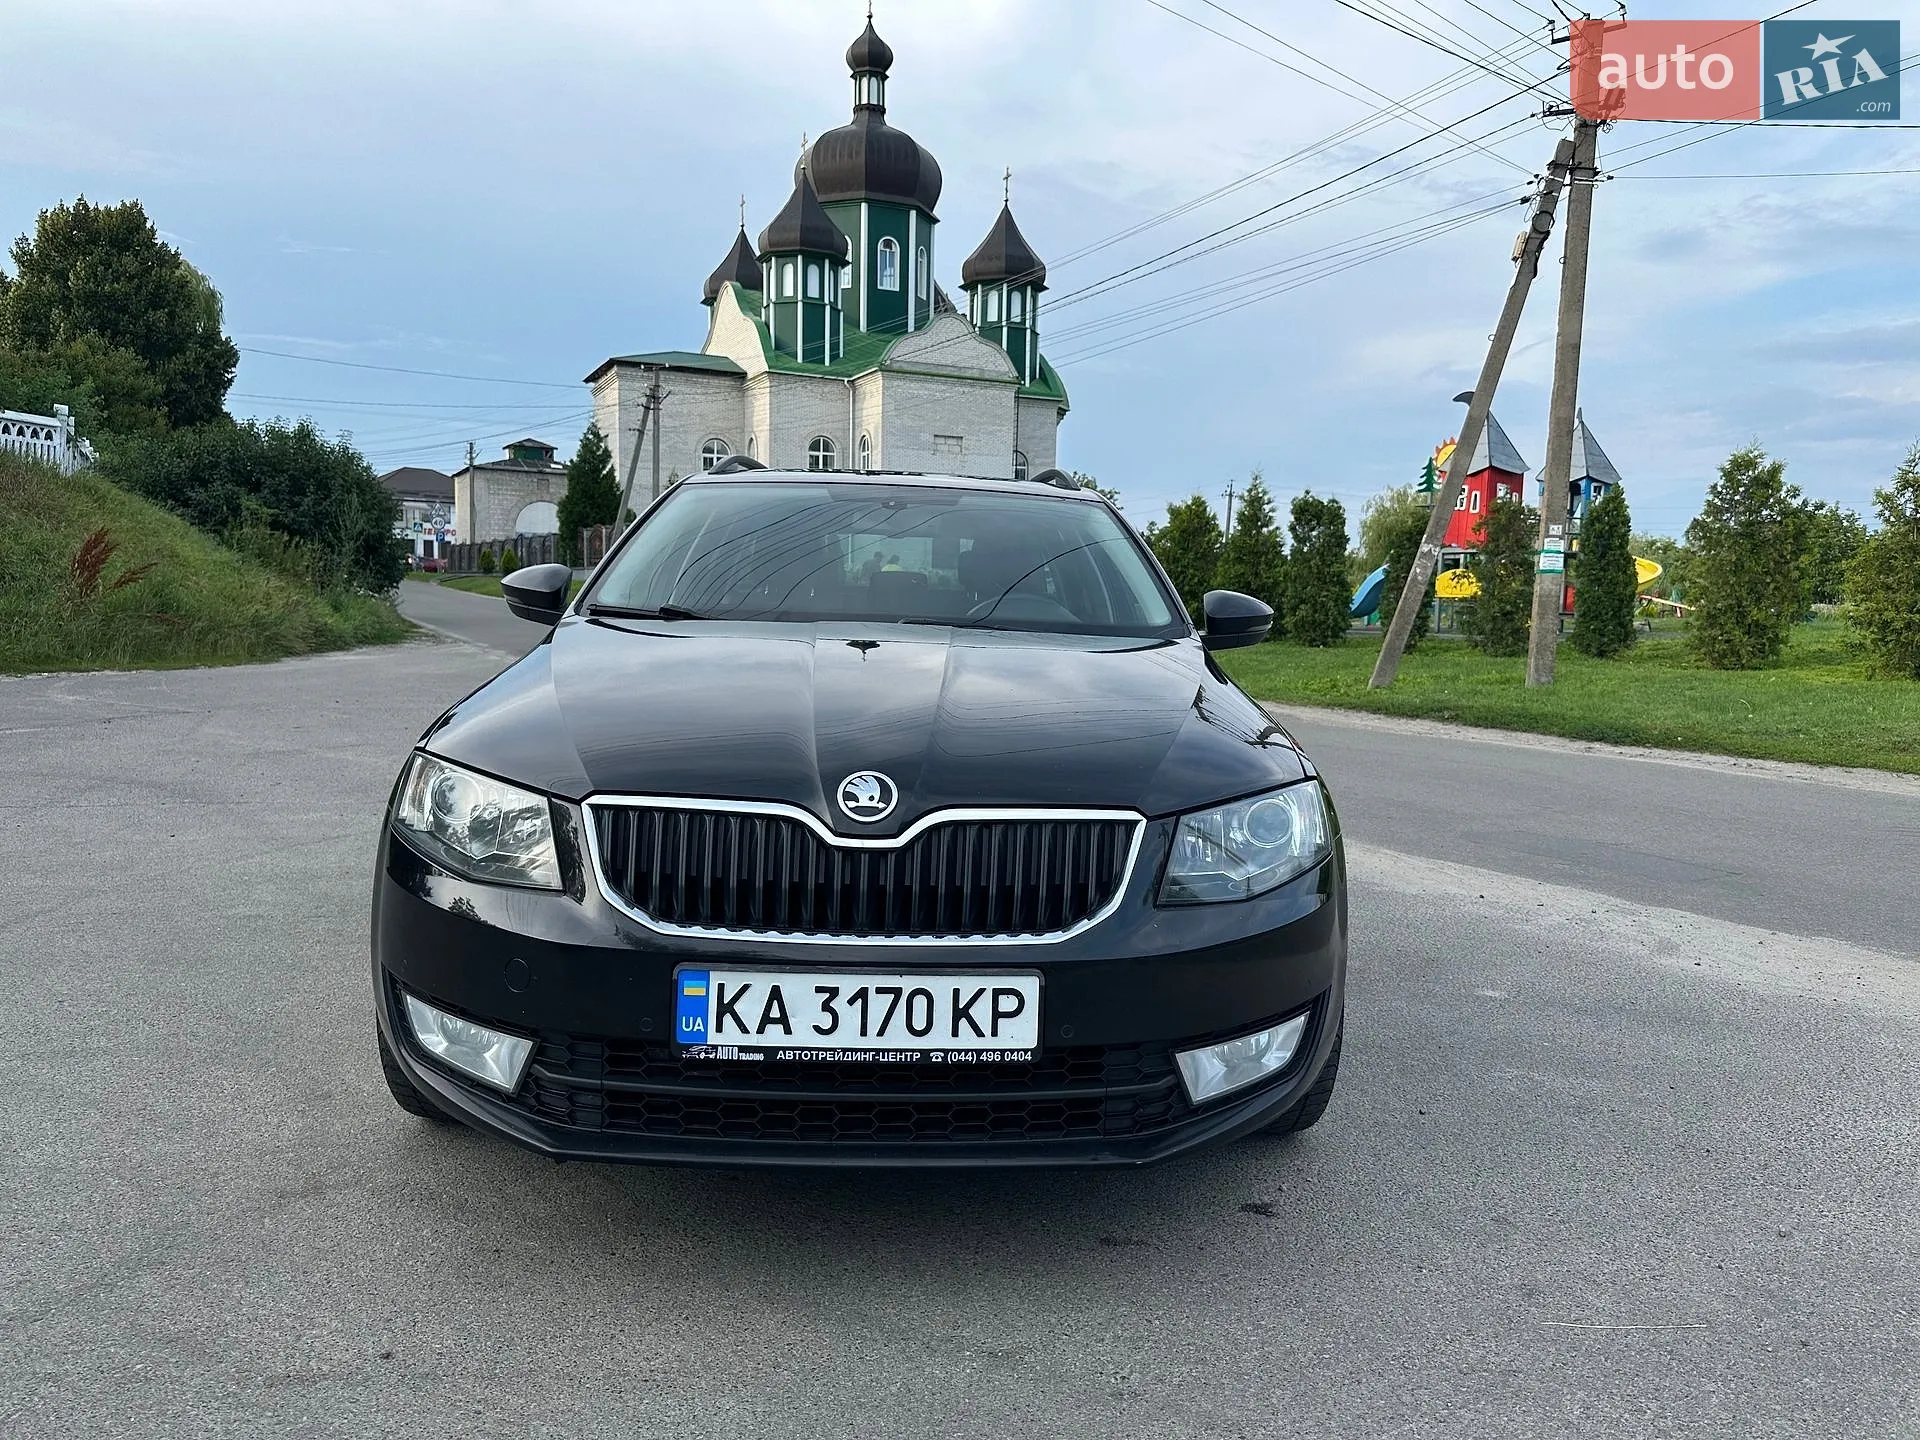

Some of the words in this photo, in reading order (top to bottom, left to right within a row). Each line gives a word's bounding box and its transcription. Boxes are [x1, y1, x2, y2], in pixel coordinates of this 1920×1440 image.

[714, 982, 793, 1036] KA
[811, 986, 935, 1038] 3170
[950, 987, 1026, 1039] KP
[682, 1016, 705, 1033] UA
[716, 1046, 739, 1061] AUTO
[739, 1052, 765, 1061] TRADING
[776, 1048, 921, 1063] АВТОТРЕЙДИНГ-ЦЕНТР
[947, 1051, 977, 1064] (044)
[979, 1051, 1002, 1063] 496
[1004, 1050, 1033, 1062] 0404
